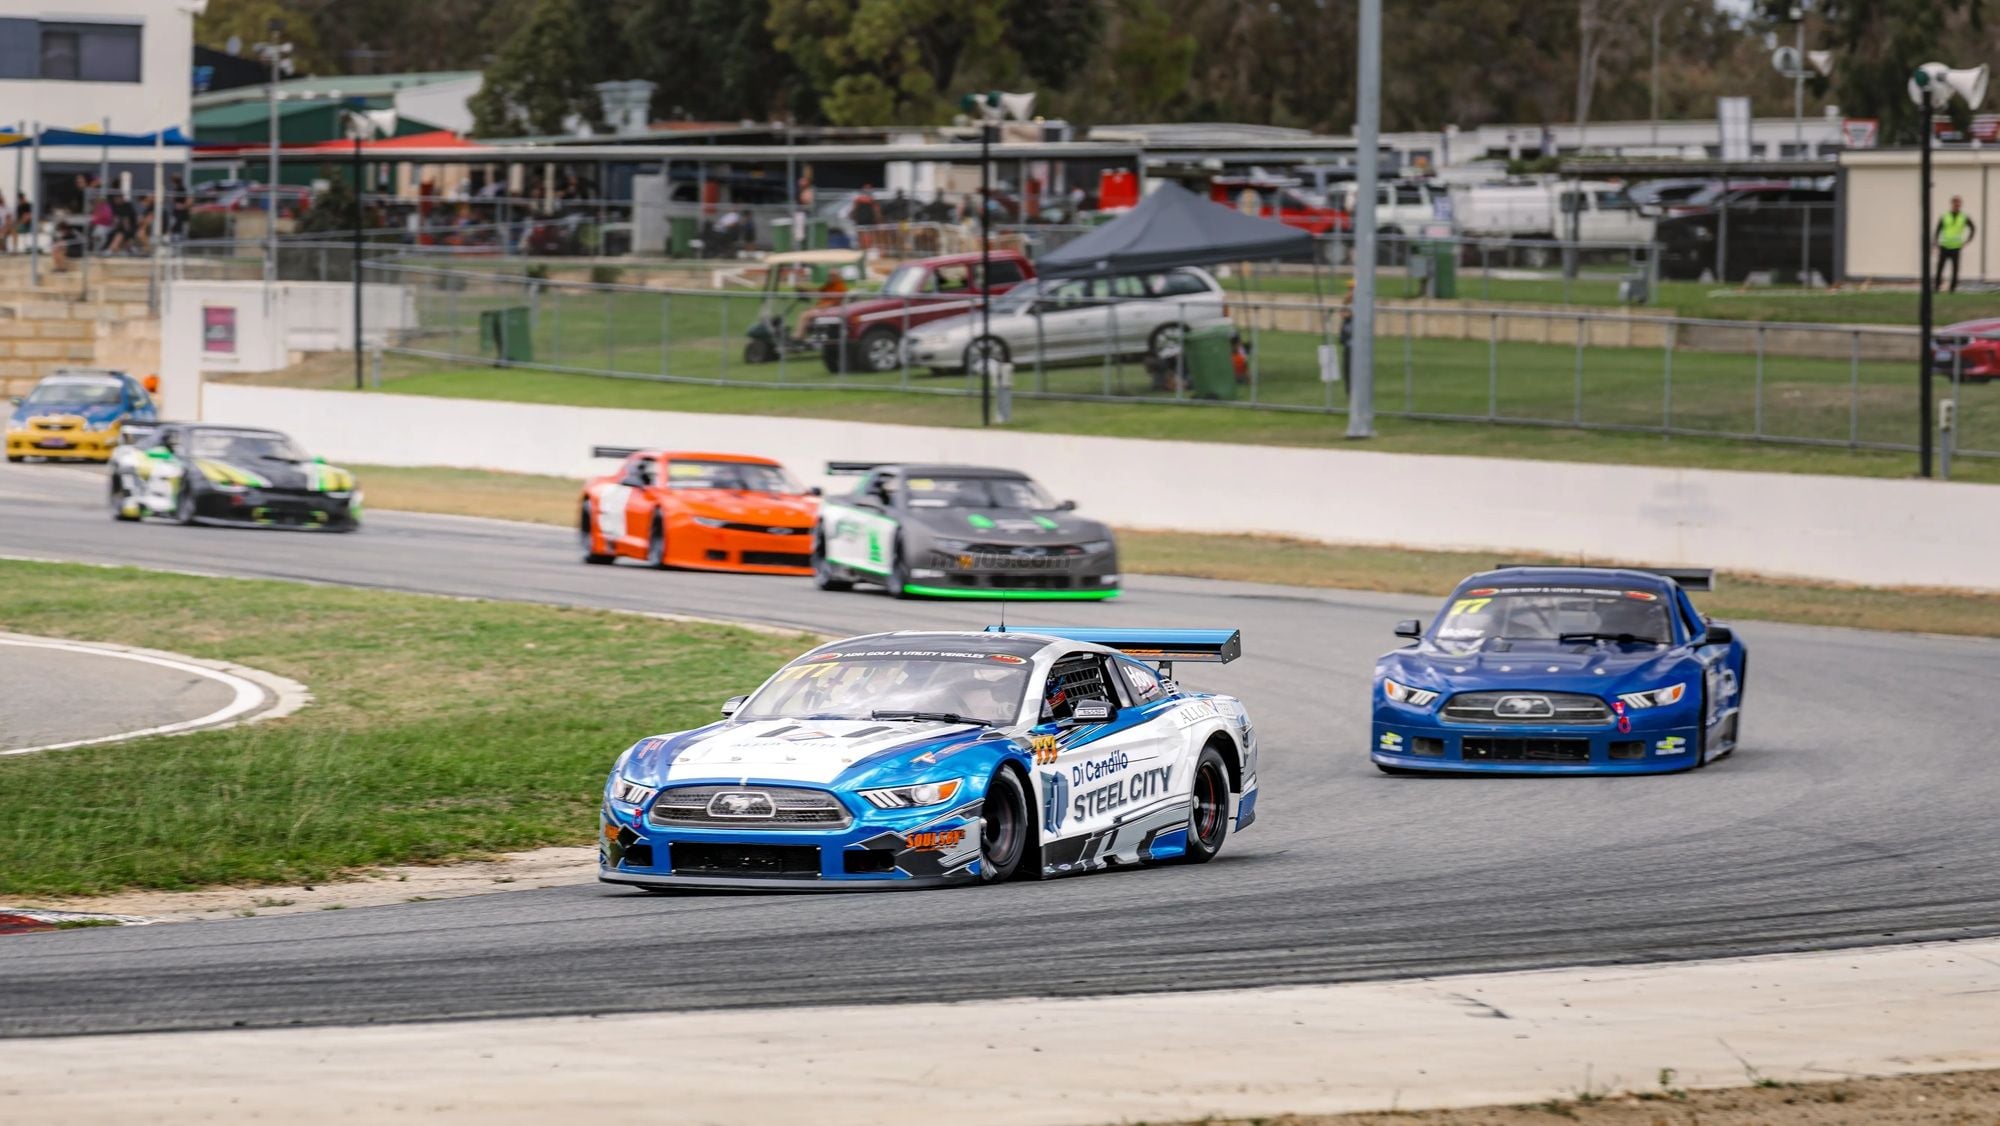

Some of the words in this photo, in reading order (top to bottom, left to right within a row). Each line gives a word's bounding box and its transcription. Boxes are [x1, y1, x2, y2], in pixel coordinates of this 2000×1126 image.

[1449, 598, 1493, 615] 77
[775, 662, 840, 682] 777
[1072, 764, 1085, 787] Di
[1086, 750, 1129, 782] Candilo
[1073, 780, 1128, 823] STEEL
[1129, 765, 1174, 801] CITY
